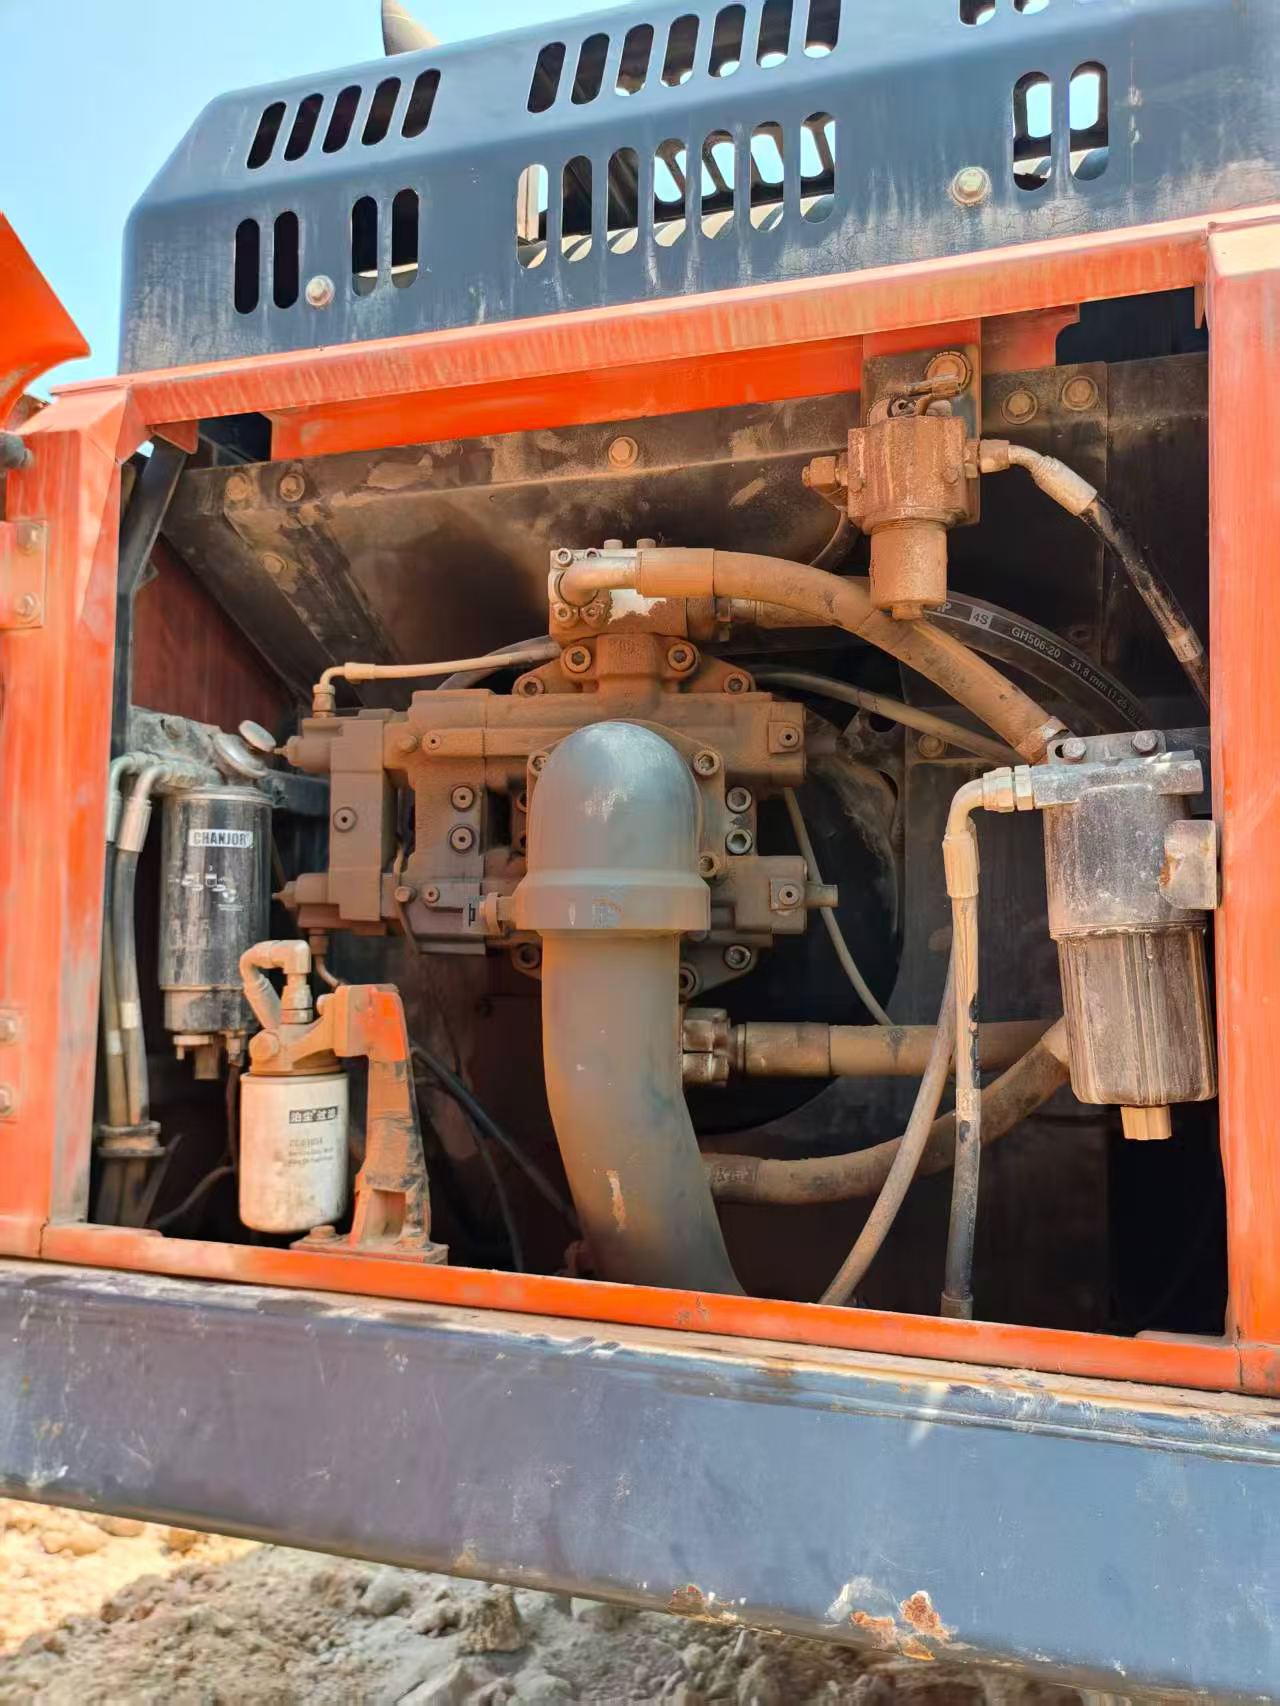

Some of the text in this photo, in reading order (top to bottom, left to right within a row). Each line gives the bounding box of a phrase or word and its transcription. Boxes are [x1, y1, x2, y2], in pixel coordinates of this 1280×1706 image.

[972, 612, 990, 625] 4S
[1011, 626, 1061, 660] GH506-20
[1069, 658, 1090, 677] 31.8
